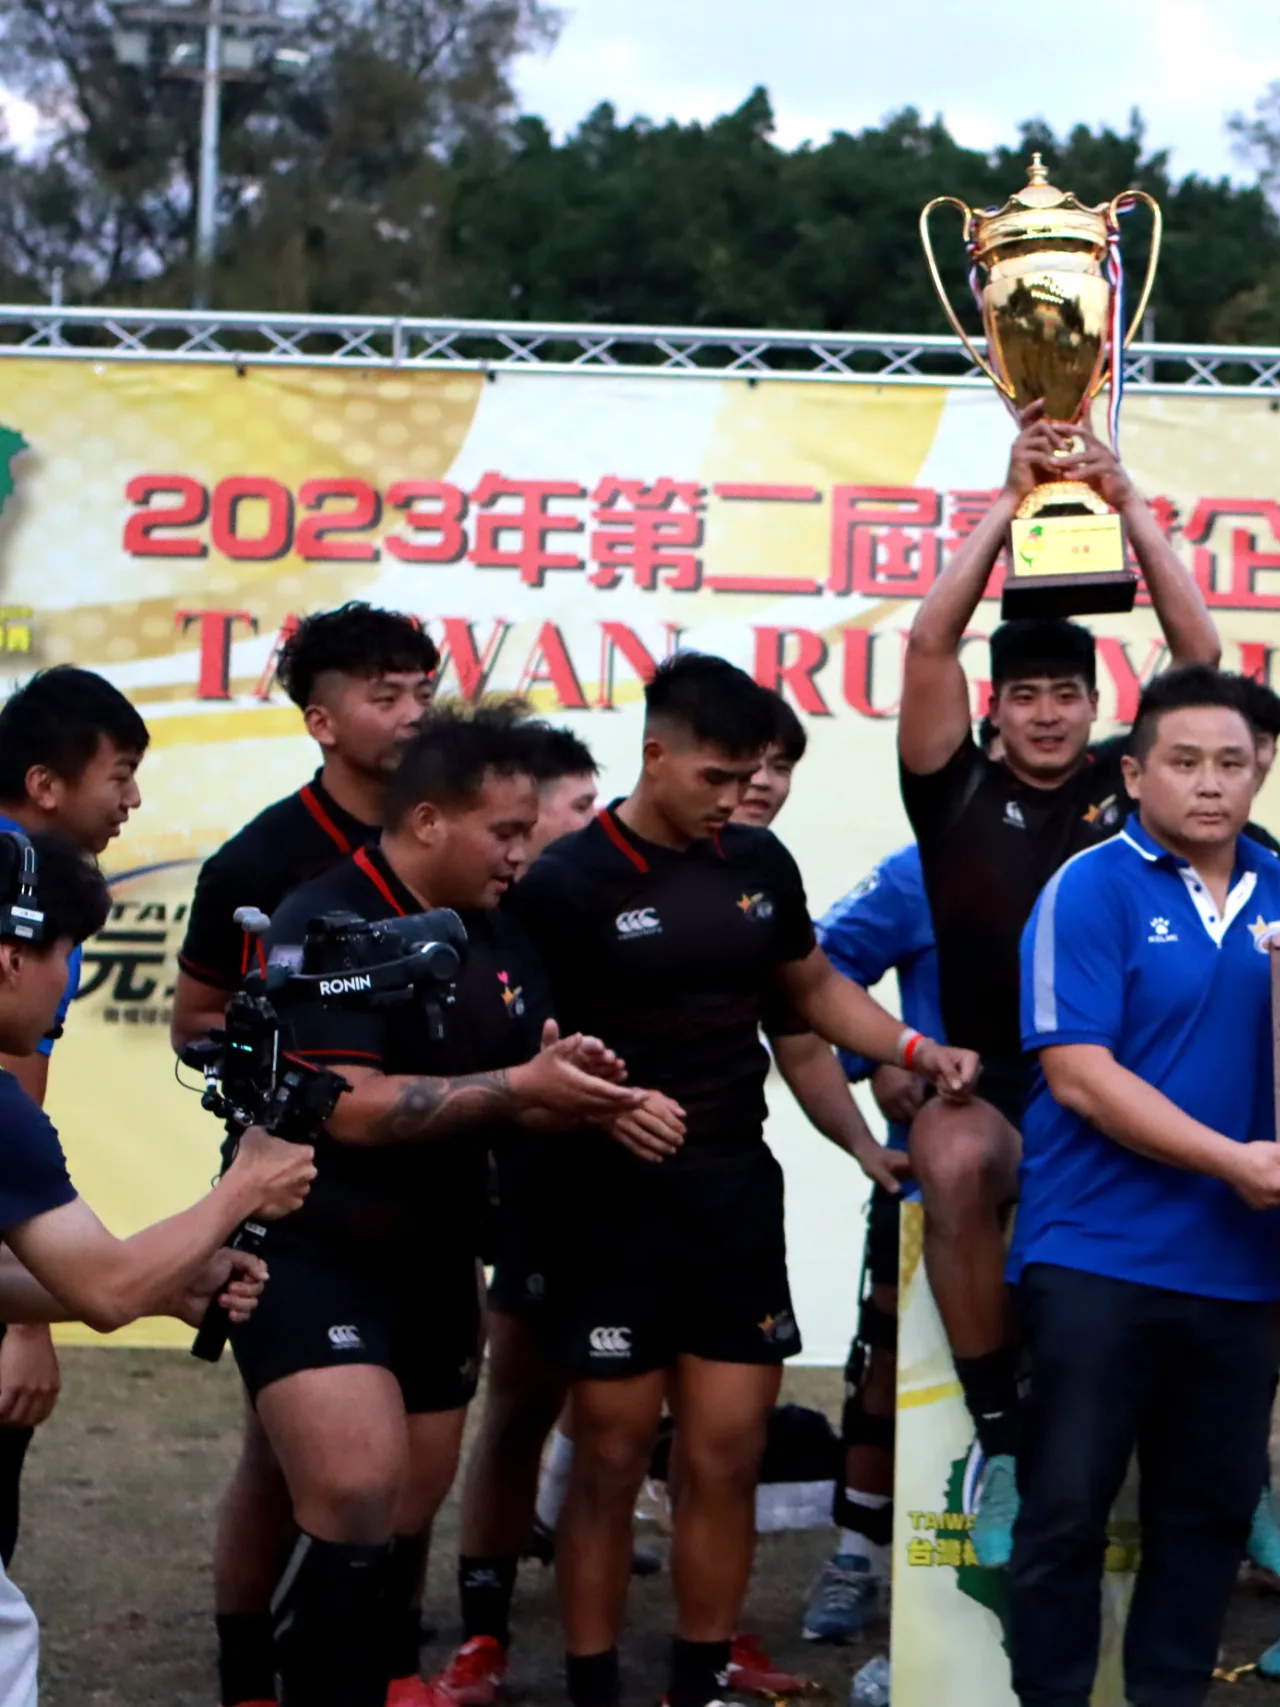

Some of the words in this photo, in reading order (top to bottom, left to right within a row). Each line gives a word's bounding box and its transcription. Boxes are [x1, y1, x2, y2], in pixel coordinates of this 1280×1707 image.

[175, 610, 686, 712] TWAN
[752, 624, 1169, 726] RUY
[72, 931, 175, 1001] 元
[320, 974, 371, 996] RONIN
